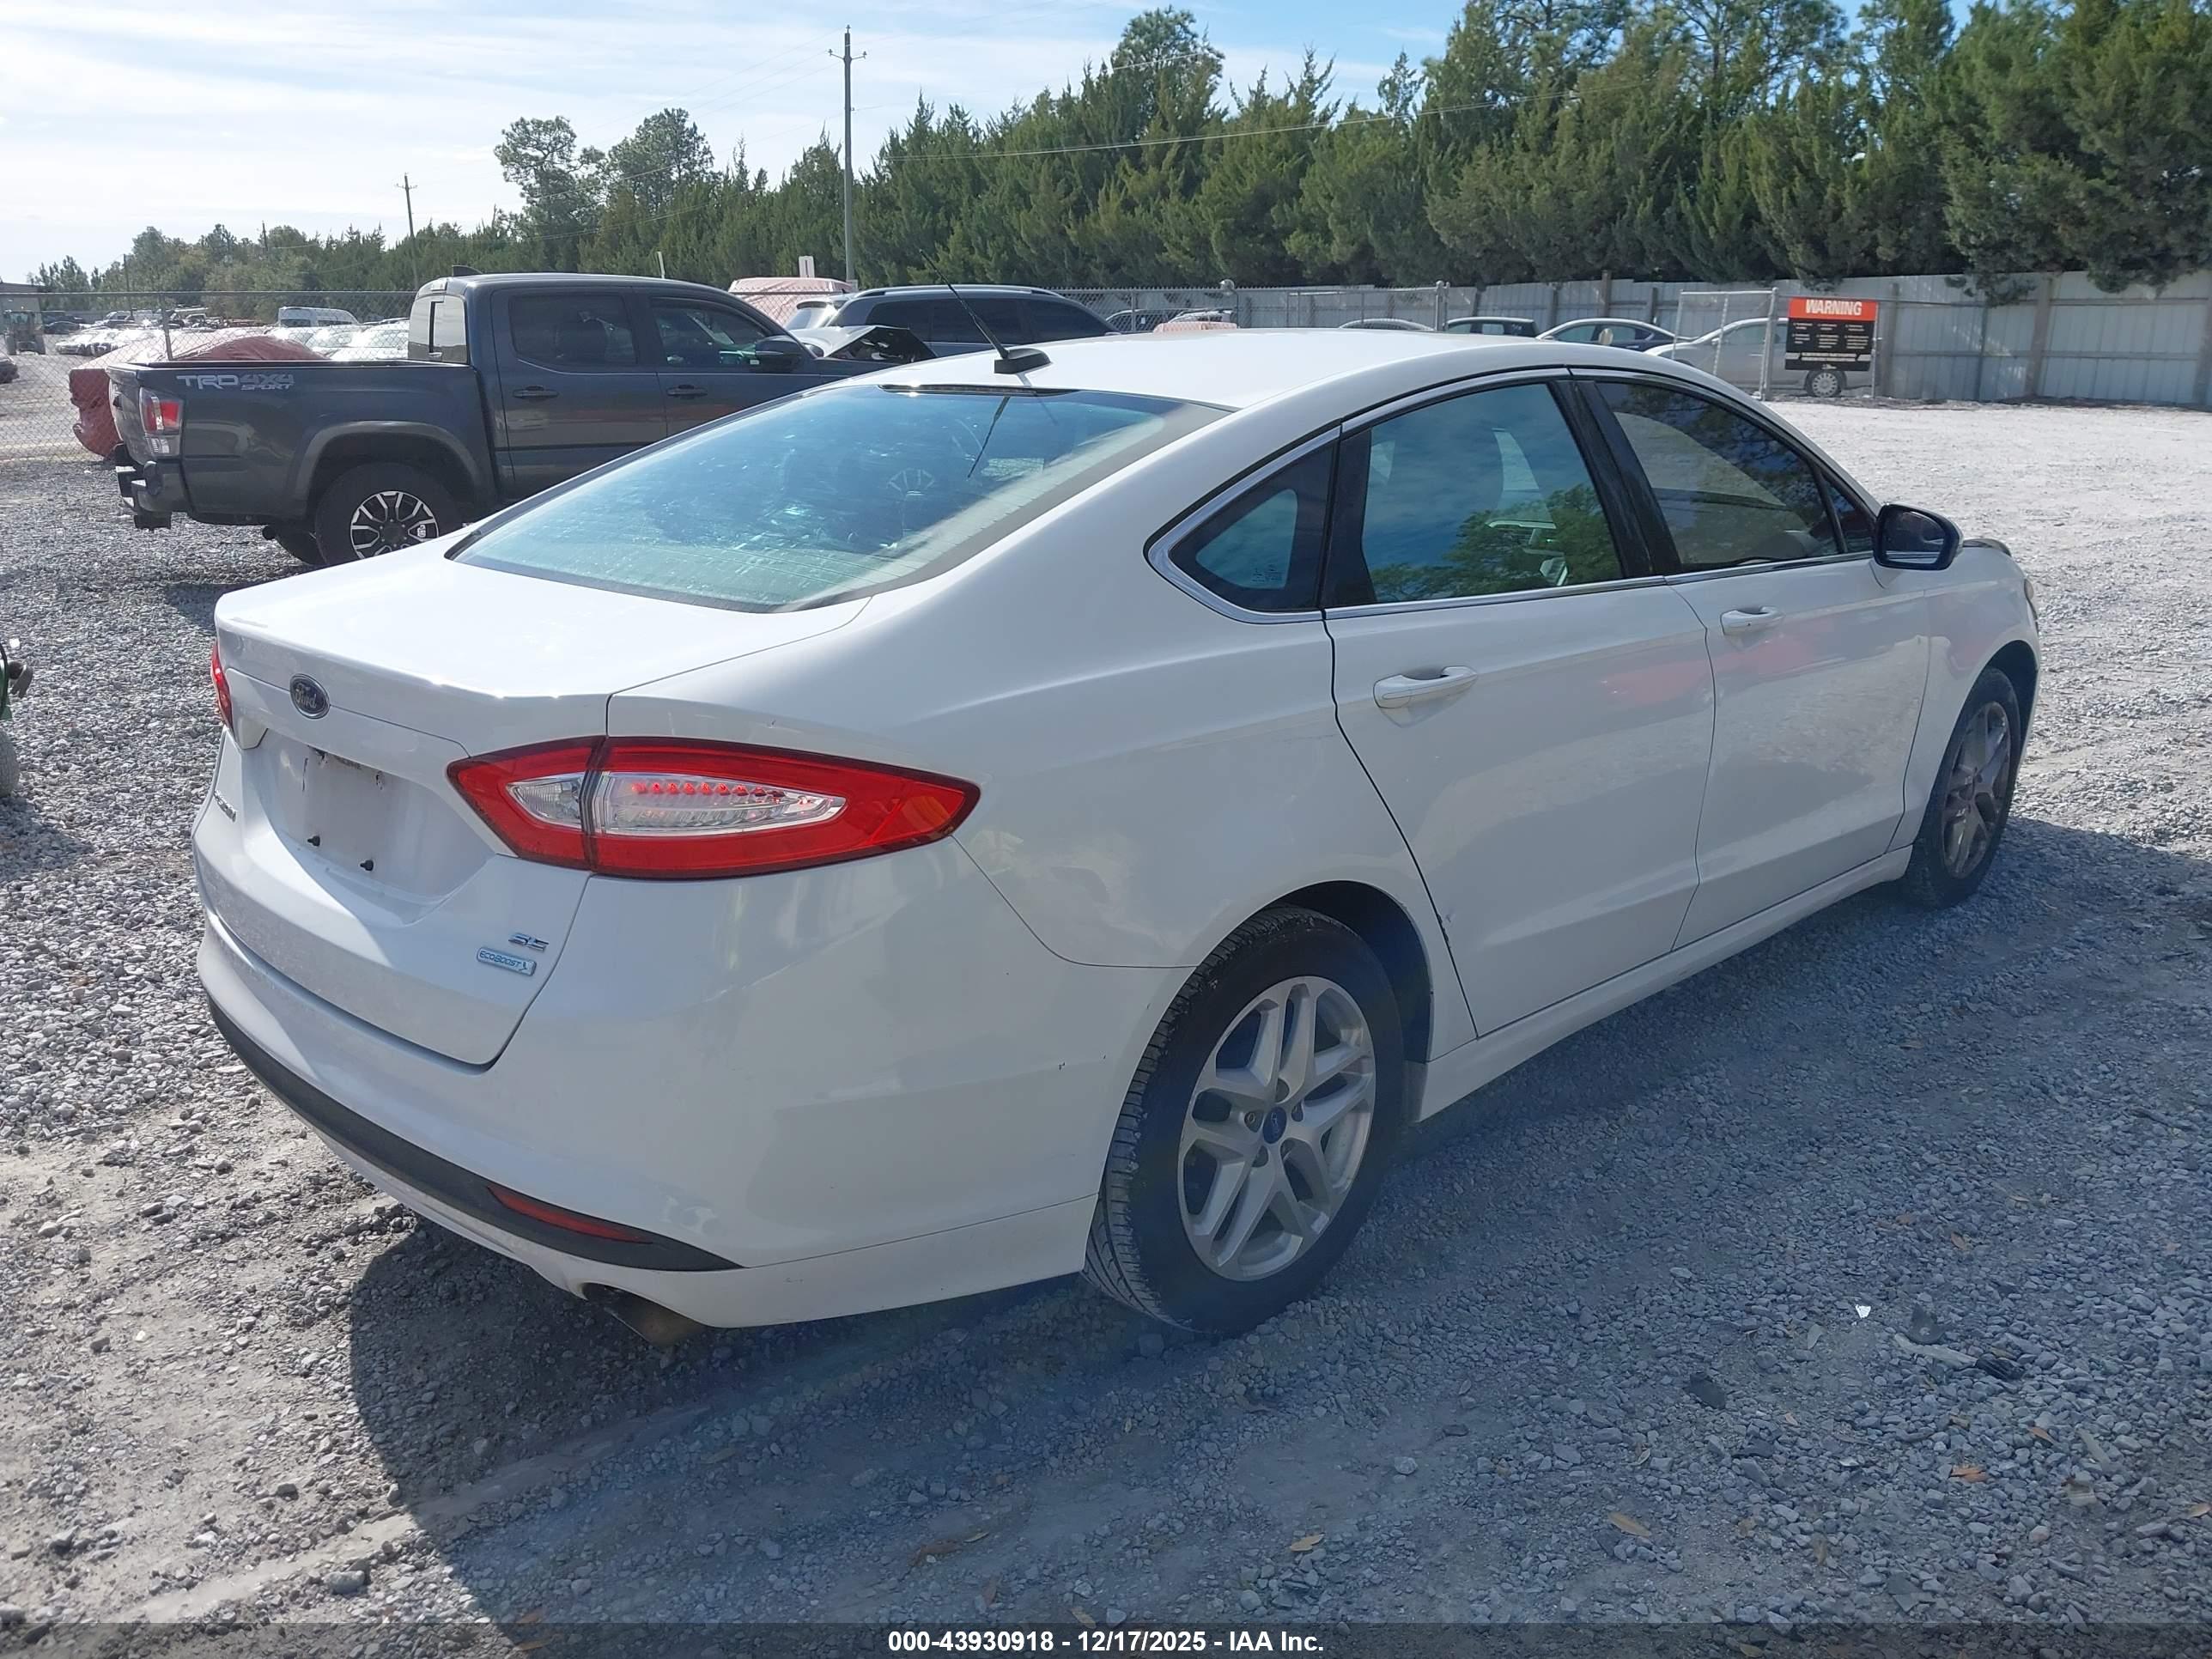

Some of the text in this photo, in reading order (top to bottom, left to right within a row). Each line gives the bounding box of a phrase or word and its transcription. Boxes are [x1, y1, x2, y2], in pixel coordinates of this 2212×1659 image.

[1806, 299, 1863, 316] WARNING
[176, 374, 239, 390] TRD
[508, 933, 550, 952] SE
